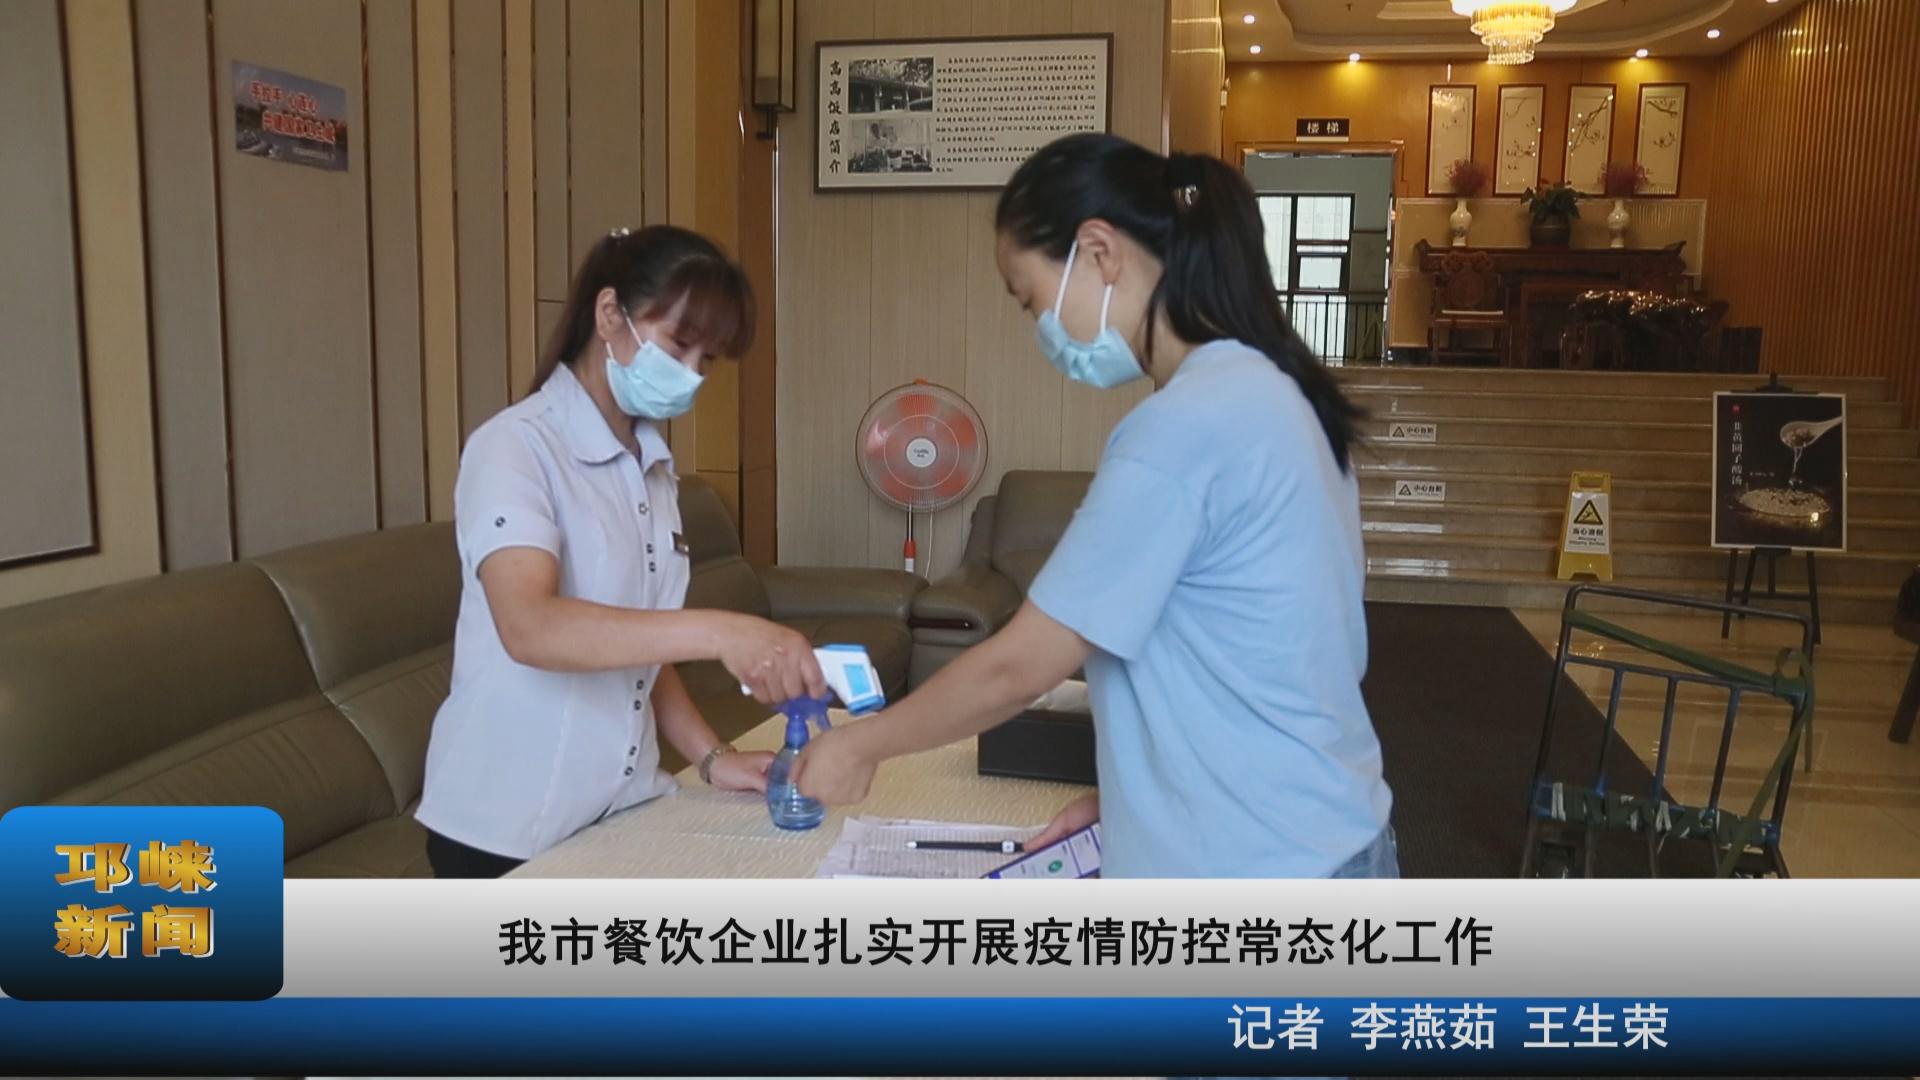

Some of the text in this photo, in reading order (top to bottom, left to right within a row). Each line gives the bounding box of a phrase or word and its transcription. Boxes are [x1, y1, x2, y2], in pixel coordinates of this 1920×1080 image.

[828, 60, 842, 174] 高高饭店简介
[1306, 121, 1339, 134] 楼梯
